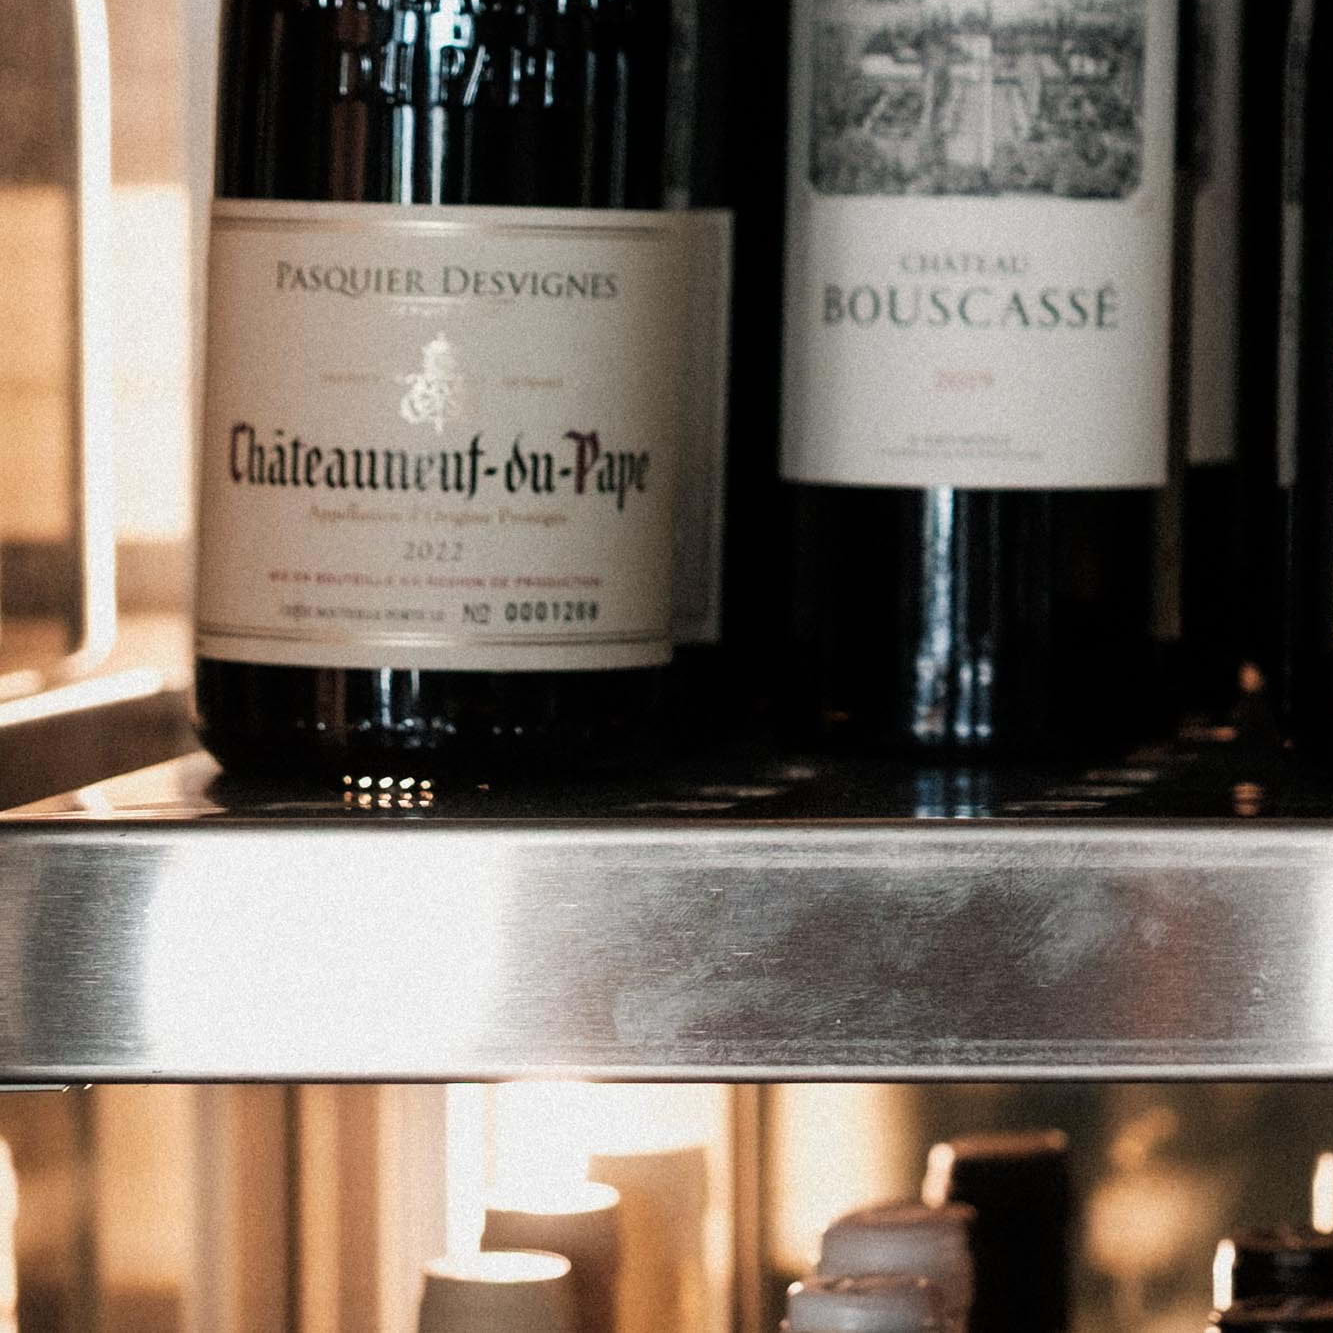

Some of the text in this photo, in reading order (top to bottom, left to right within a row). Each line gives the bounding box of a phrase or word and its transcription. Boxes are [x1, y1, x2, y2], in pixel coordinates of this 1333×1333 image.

[275, 261, 619, 300] PASQUIER DESVIGNES
[823, 281, 1119, 331] BOUSCASSÉ
[229, 422, 650, 512] Châteauneuf-du-Pape
[401, 540, 464, 563] 2022
